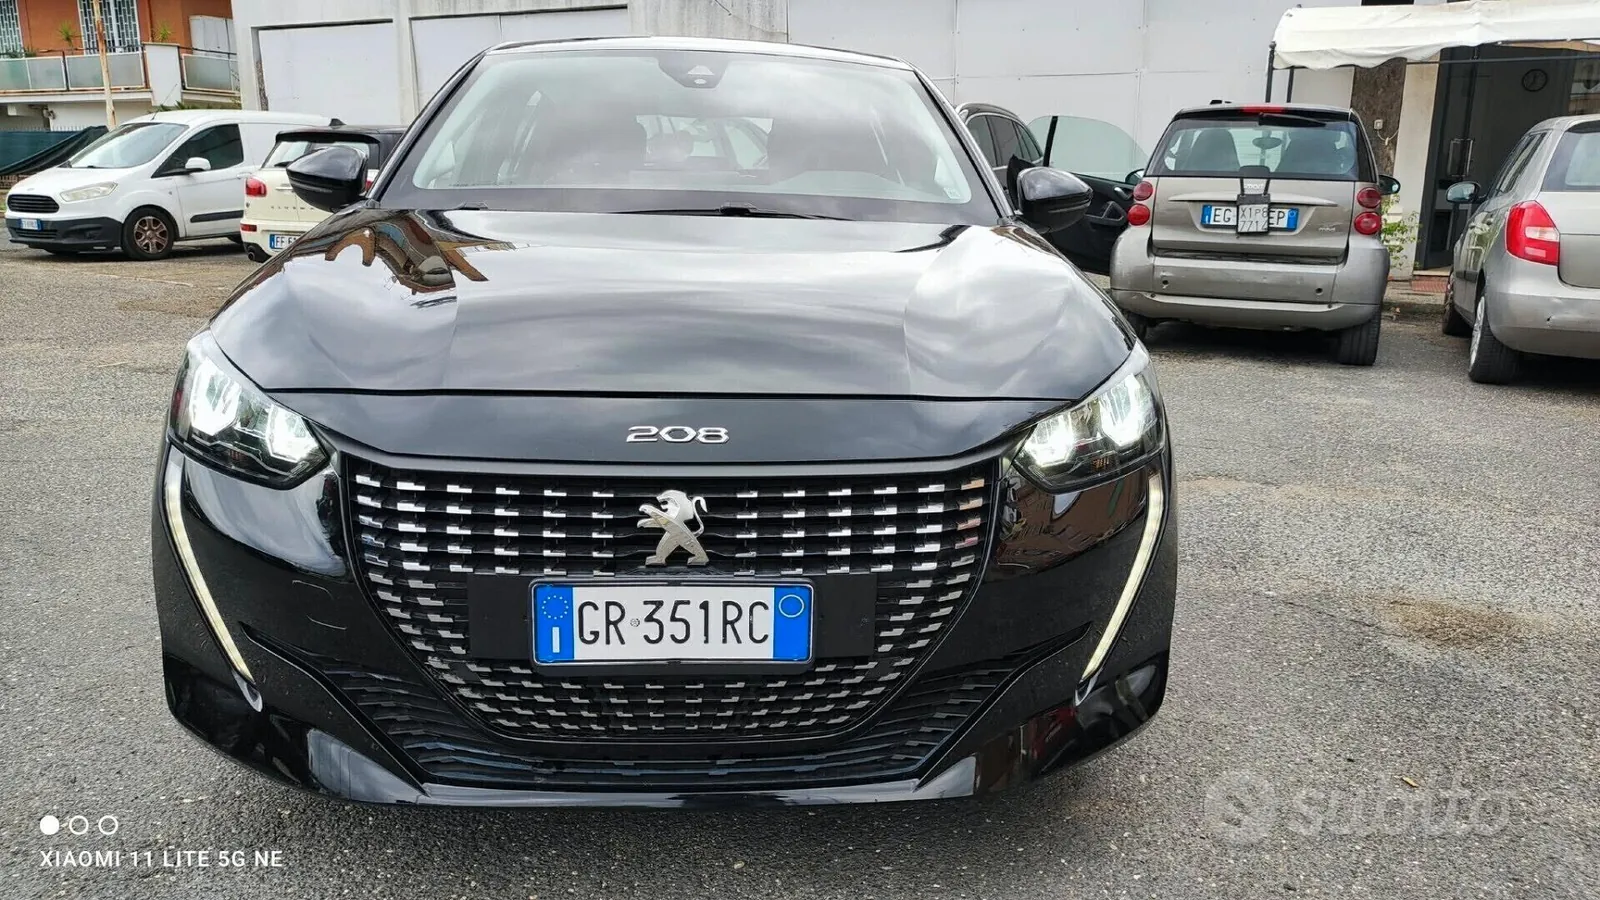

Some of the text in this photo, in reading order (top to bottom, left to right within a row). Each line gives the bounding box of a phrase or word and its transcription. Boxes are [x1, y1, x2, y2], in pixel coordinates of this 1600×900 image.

[1213, 208, 1231, 223] EG
[276, 236, 285, 247] FF
[626, 425, 729, 444] 208
[578, 600, 626, 645] GR
[643, 600, 769, 644] 351RC
